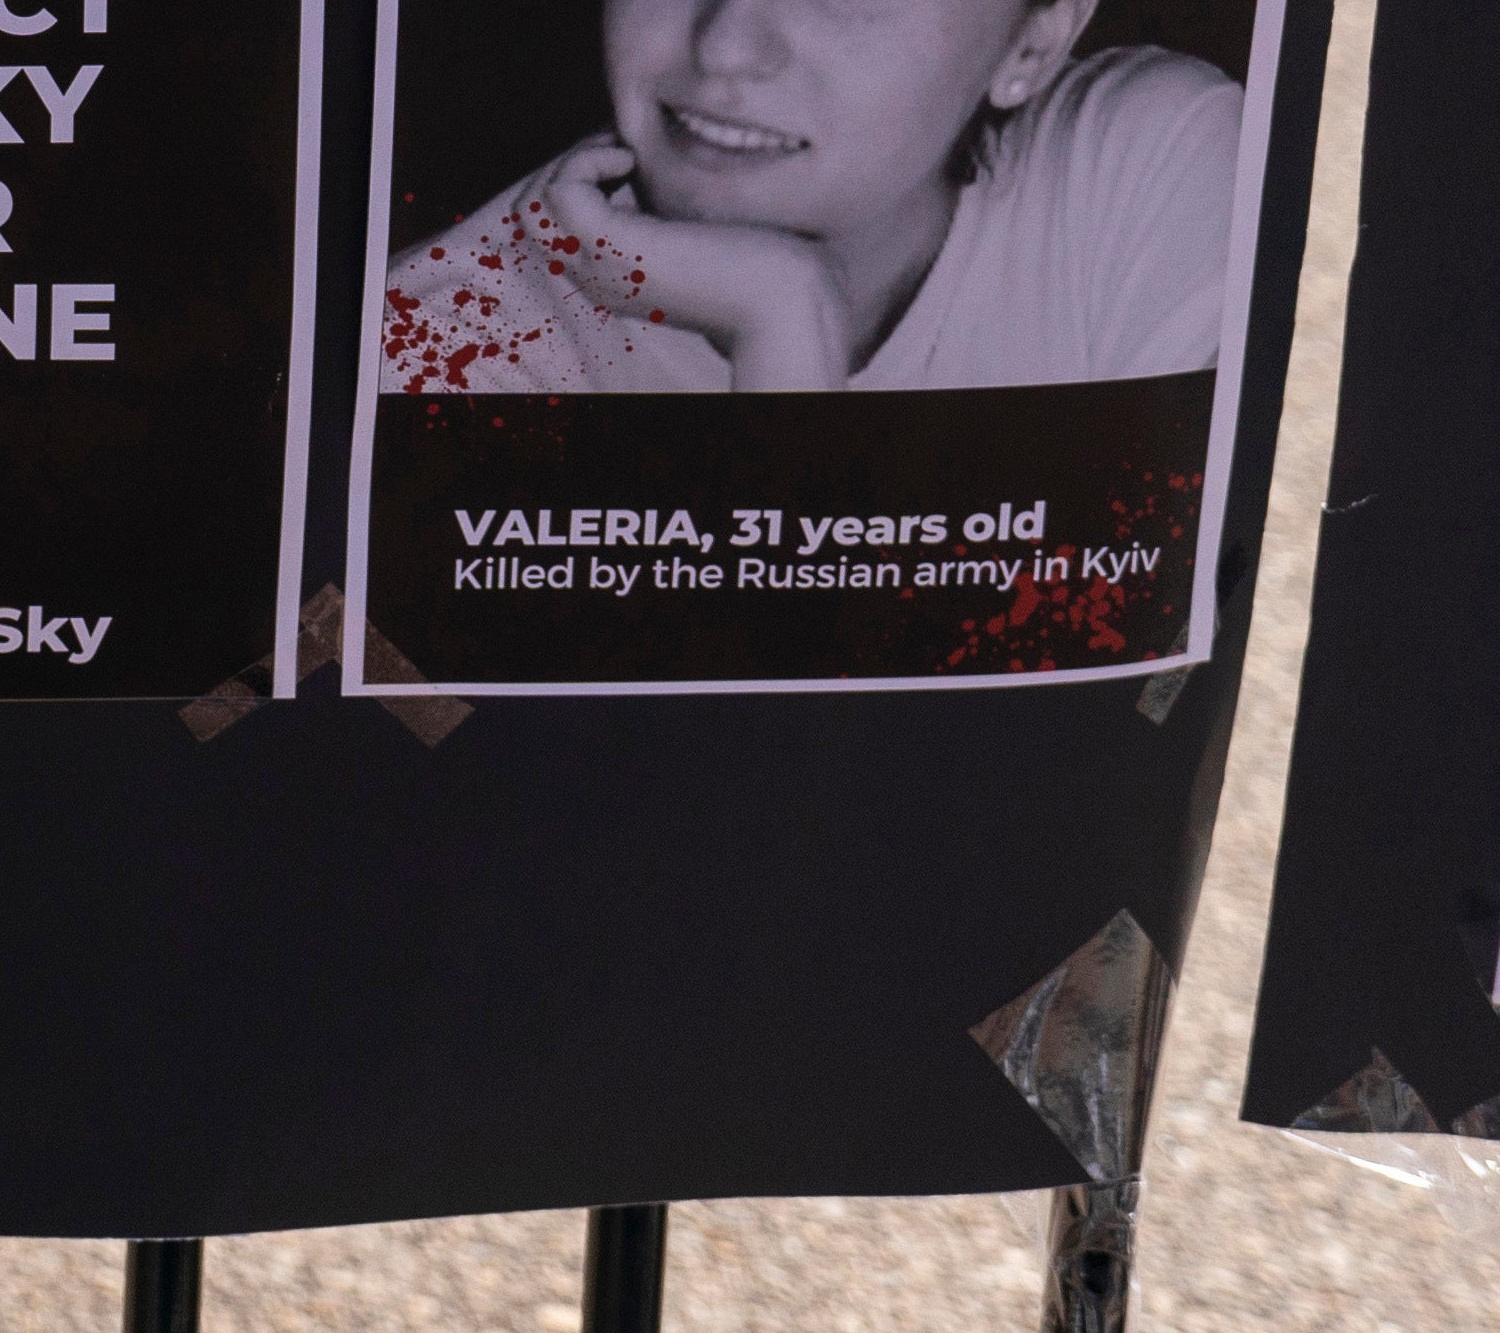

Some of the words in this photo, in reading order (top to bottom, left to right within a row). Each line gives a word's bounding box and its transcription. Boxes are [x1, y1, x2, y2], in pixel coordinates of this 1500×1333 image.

[454, 508, 715, 554] VALERIA,
[729, 509, 784, 547] 31
[795, 513, 948, 556] years
[962, 500, 1047, 543] old
[453, 556, 576, 591] Killed
[588, 556, 642, 597] by
[651, 556, 725, 590] the
[736, 555, 902, 590] Russian
[912, 559, 1024, 592] army
[1031, 549, 1071, 582] in
[1080, 541, 1162, 584] Kyiv
